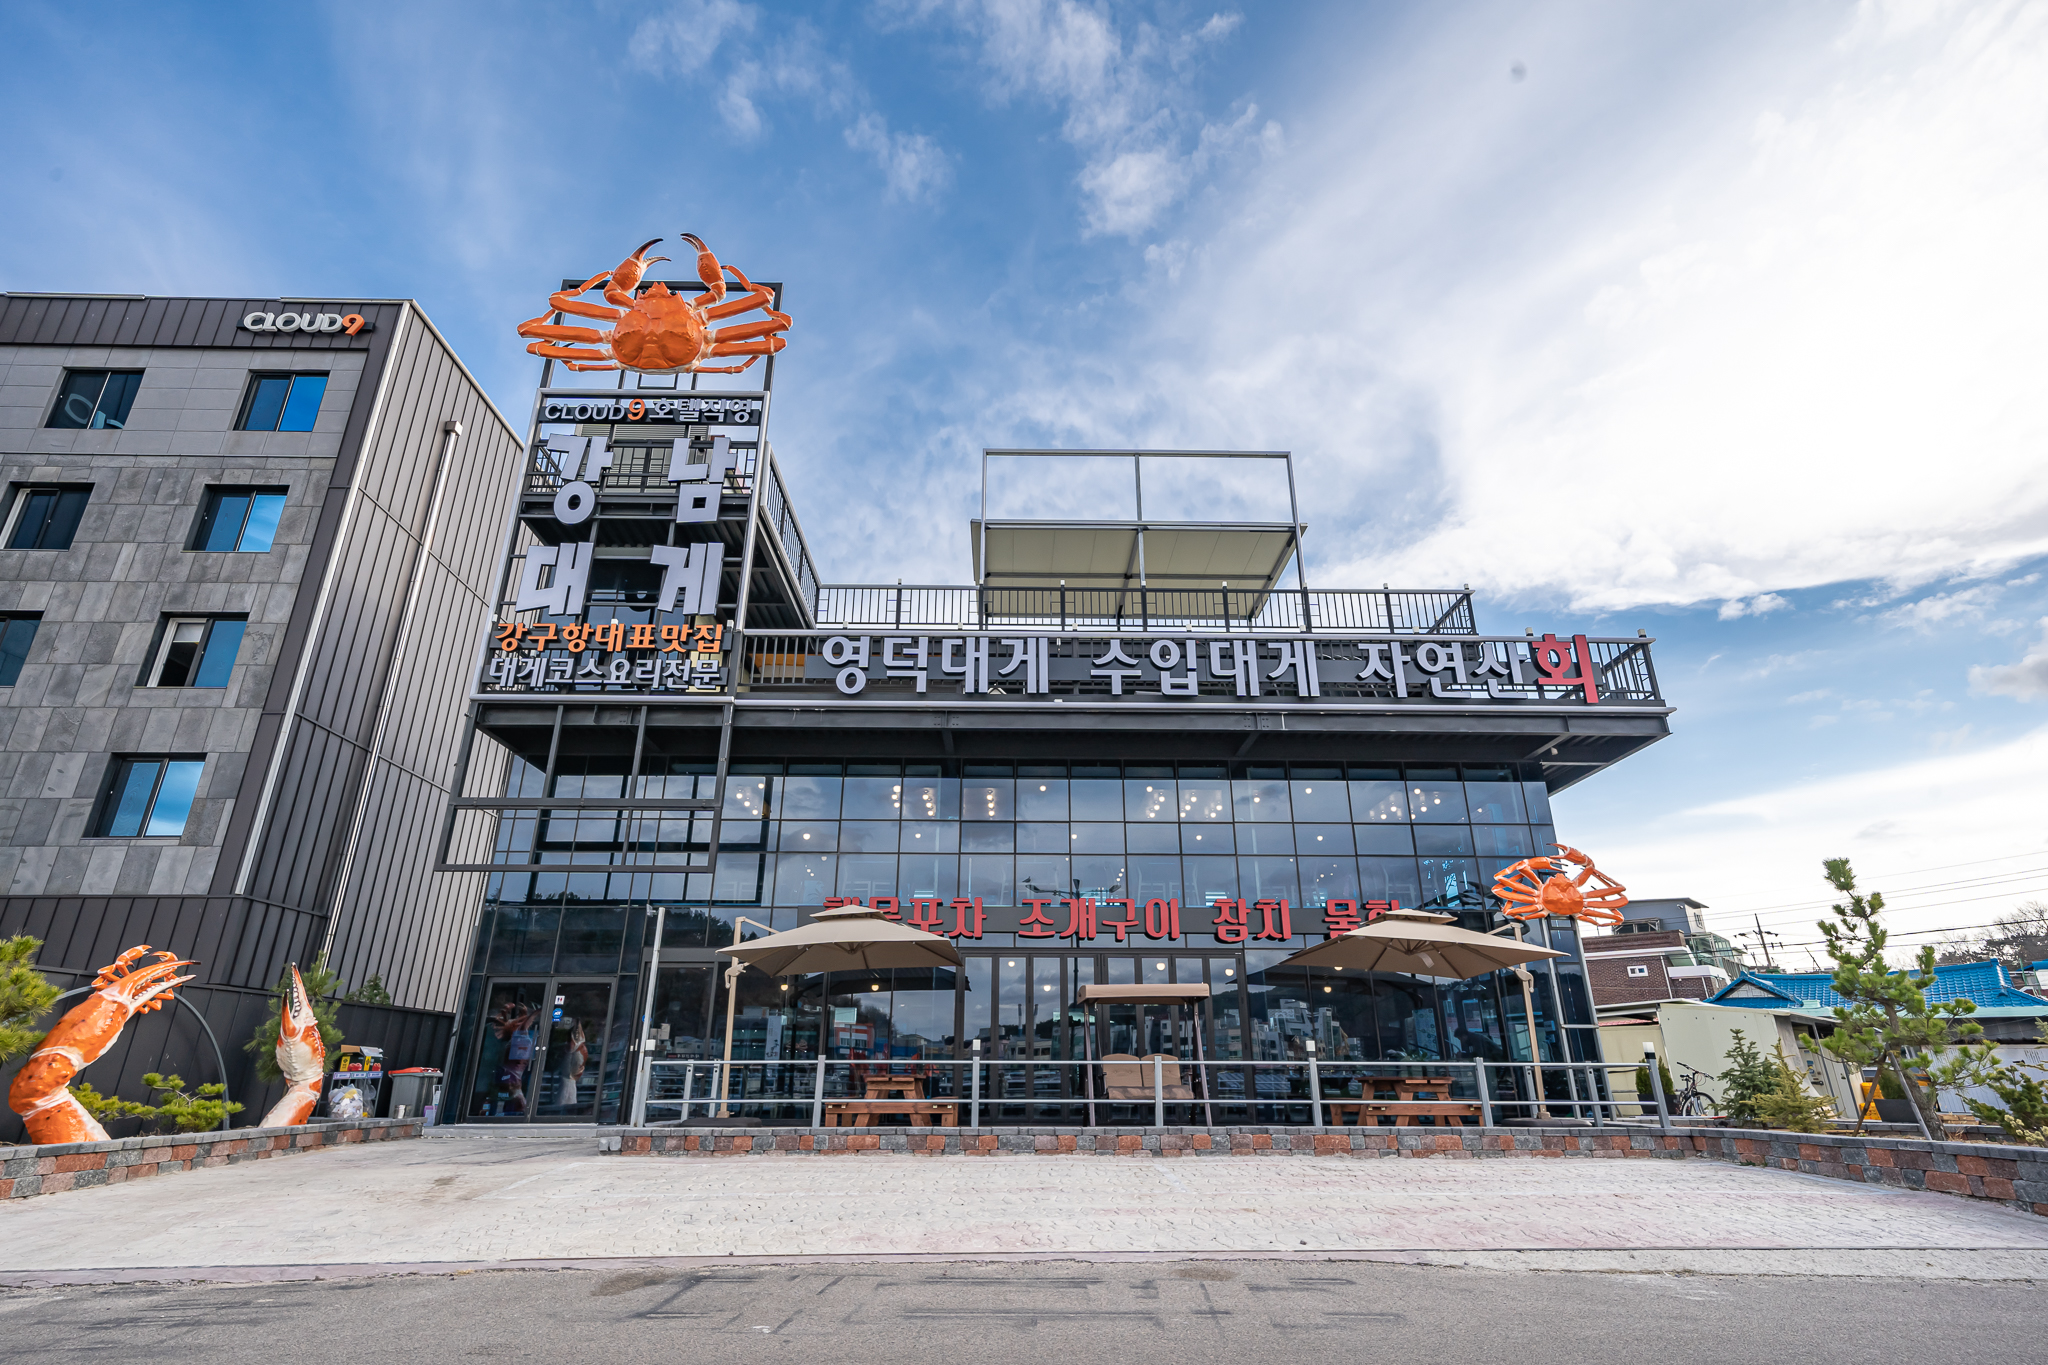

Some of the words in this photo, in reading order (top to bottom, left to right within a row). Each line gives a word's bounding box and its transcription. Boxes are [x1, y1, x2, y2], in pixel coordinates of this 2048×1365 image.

[243, 311, 365, 336] CLOUD9
[544, 398, 646, 421] CLOUD9
[649, 397, 752, 423] 호텔직영
[822, 635, 1049, 695] 영덕대게
[1090, 637, 1320, 698] 수입대게
[1018, 898, 1180, 941] 조개구이
[1213, 898, 1292, 942] 참치
